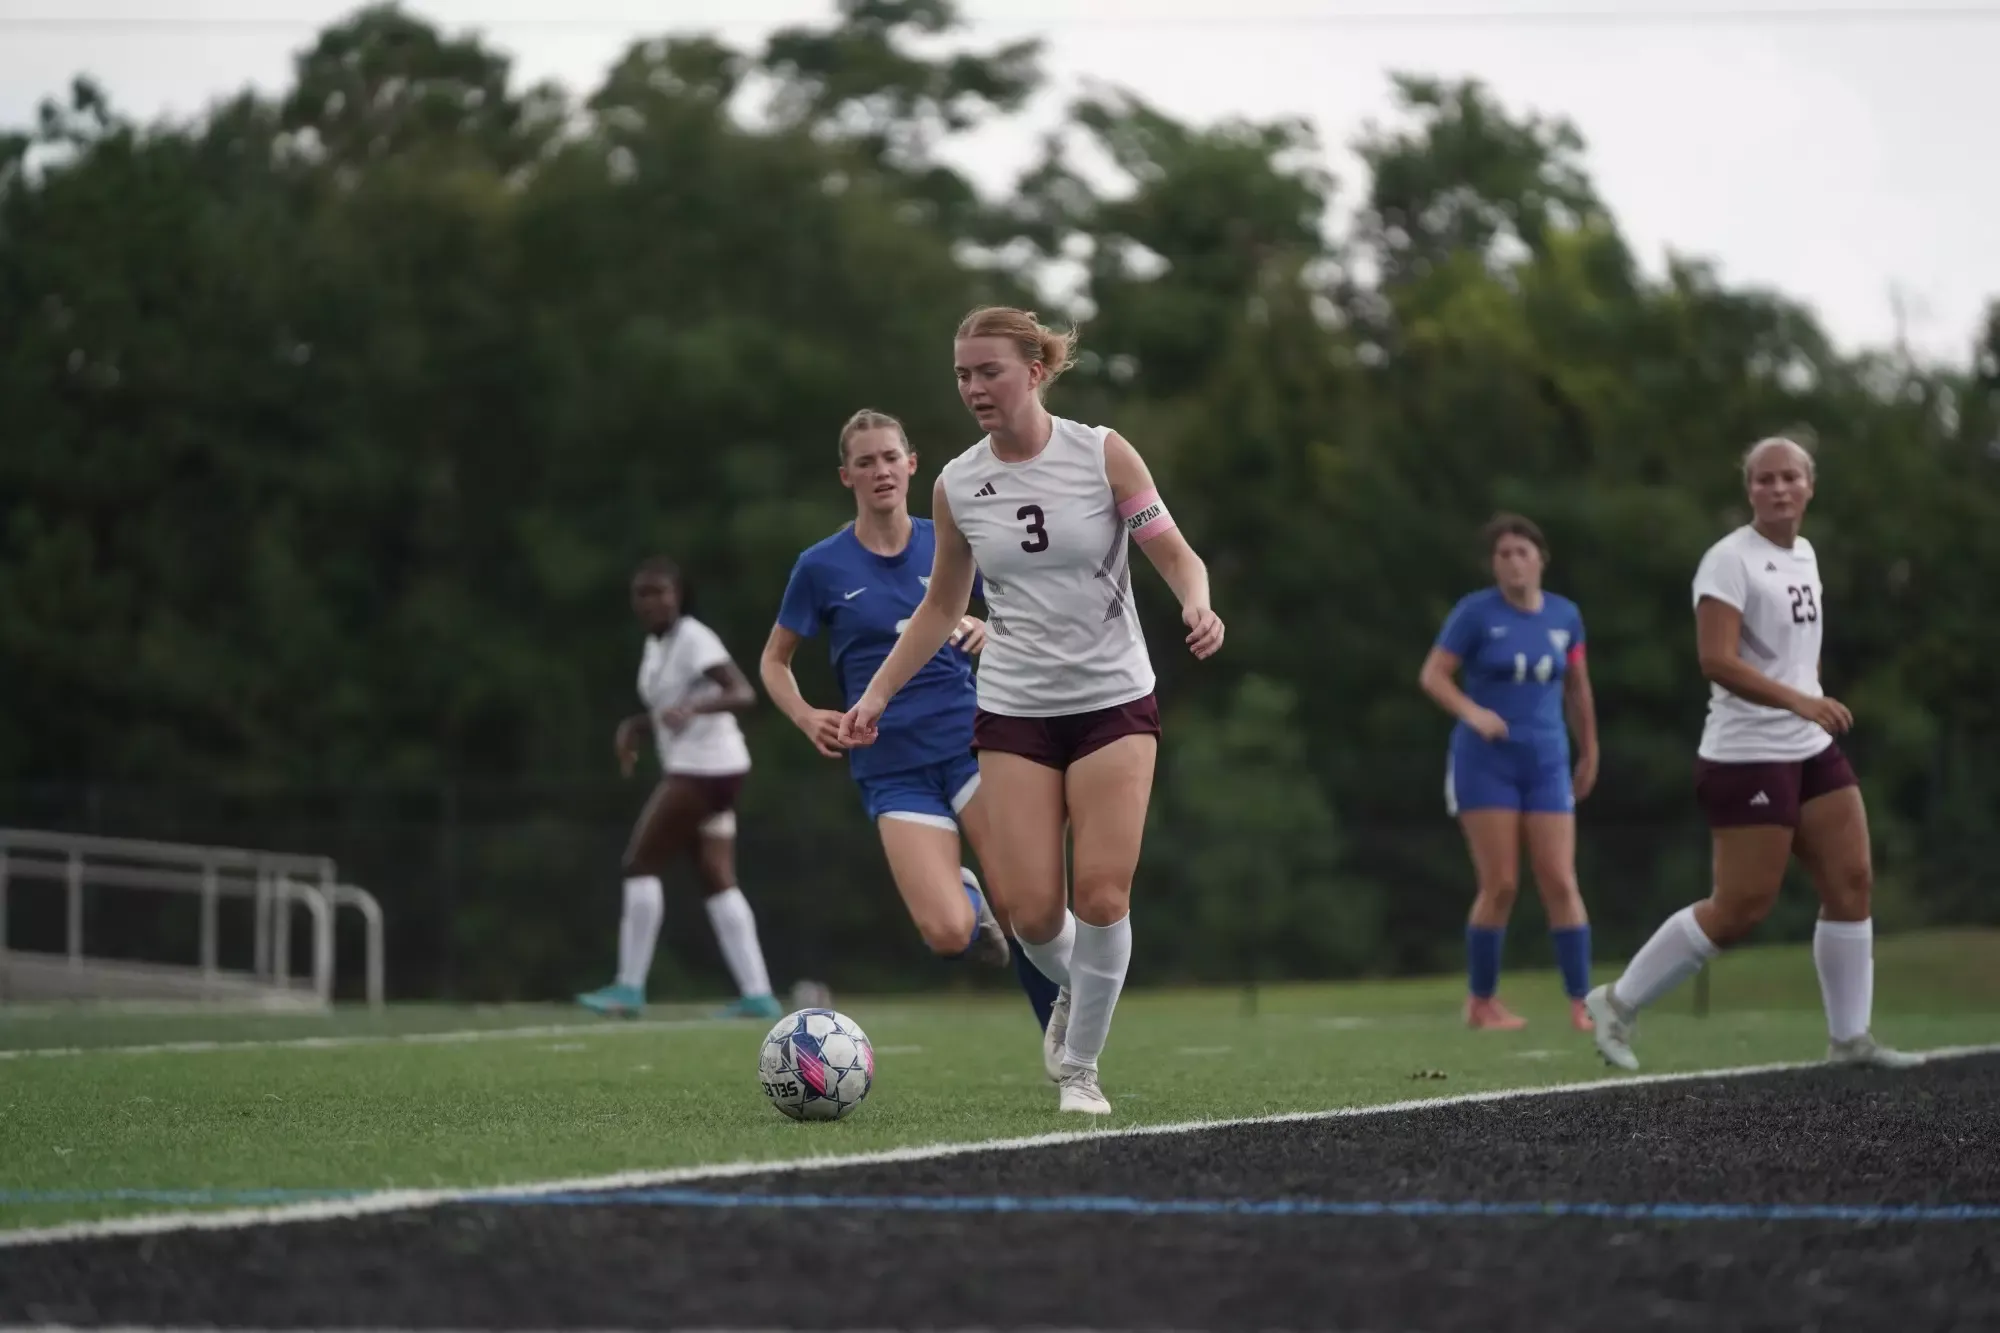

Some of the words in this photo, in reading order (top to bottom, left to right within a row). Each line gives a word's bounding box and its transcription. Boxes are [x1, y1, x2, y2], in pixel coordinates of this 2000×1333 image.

[1016, 504, 1049, 553] 3
[1127, 504, 1161, 529] CAPTAIN
[1787, 584, 1817, 623] 23
